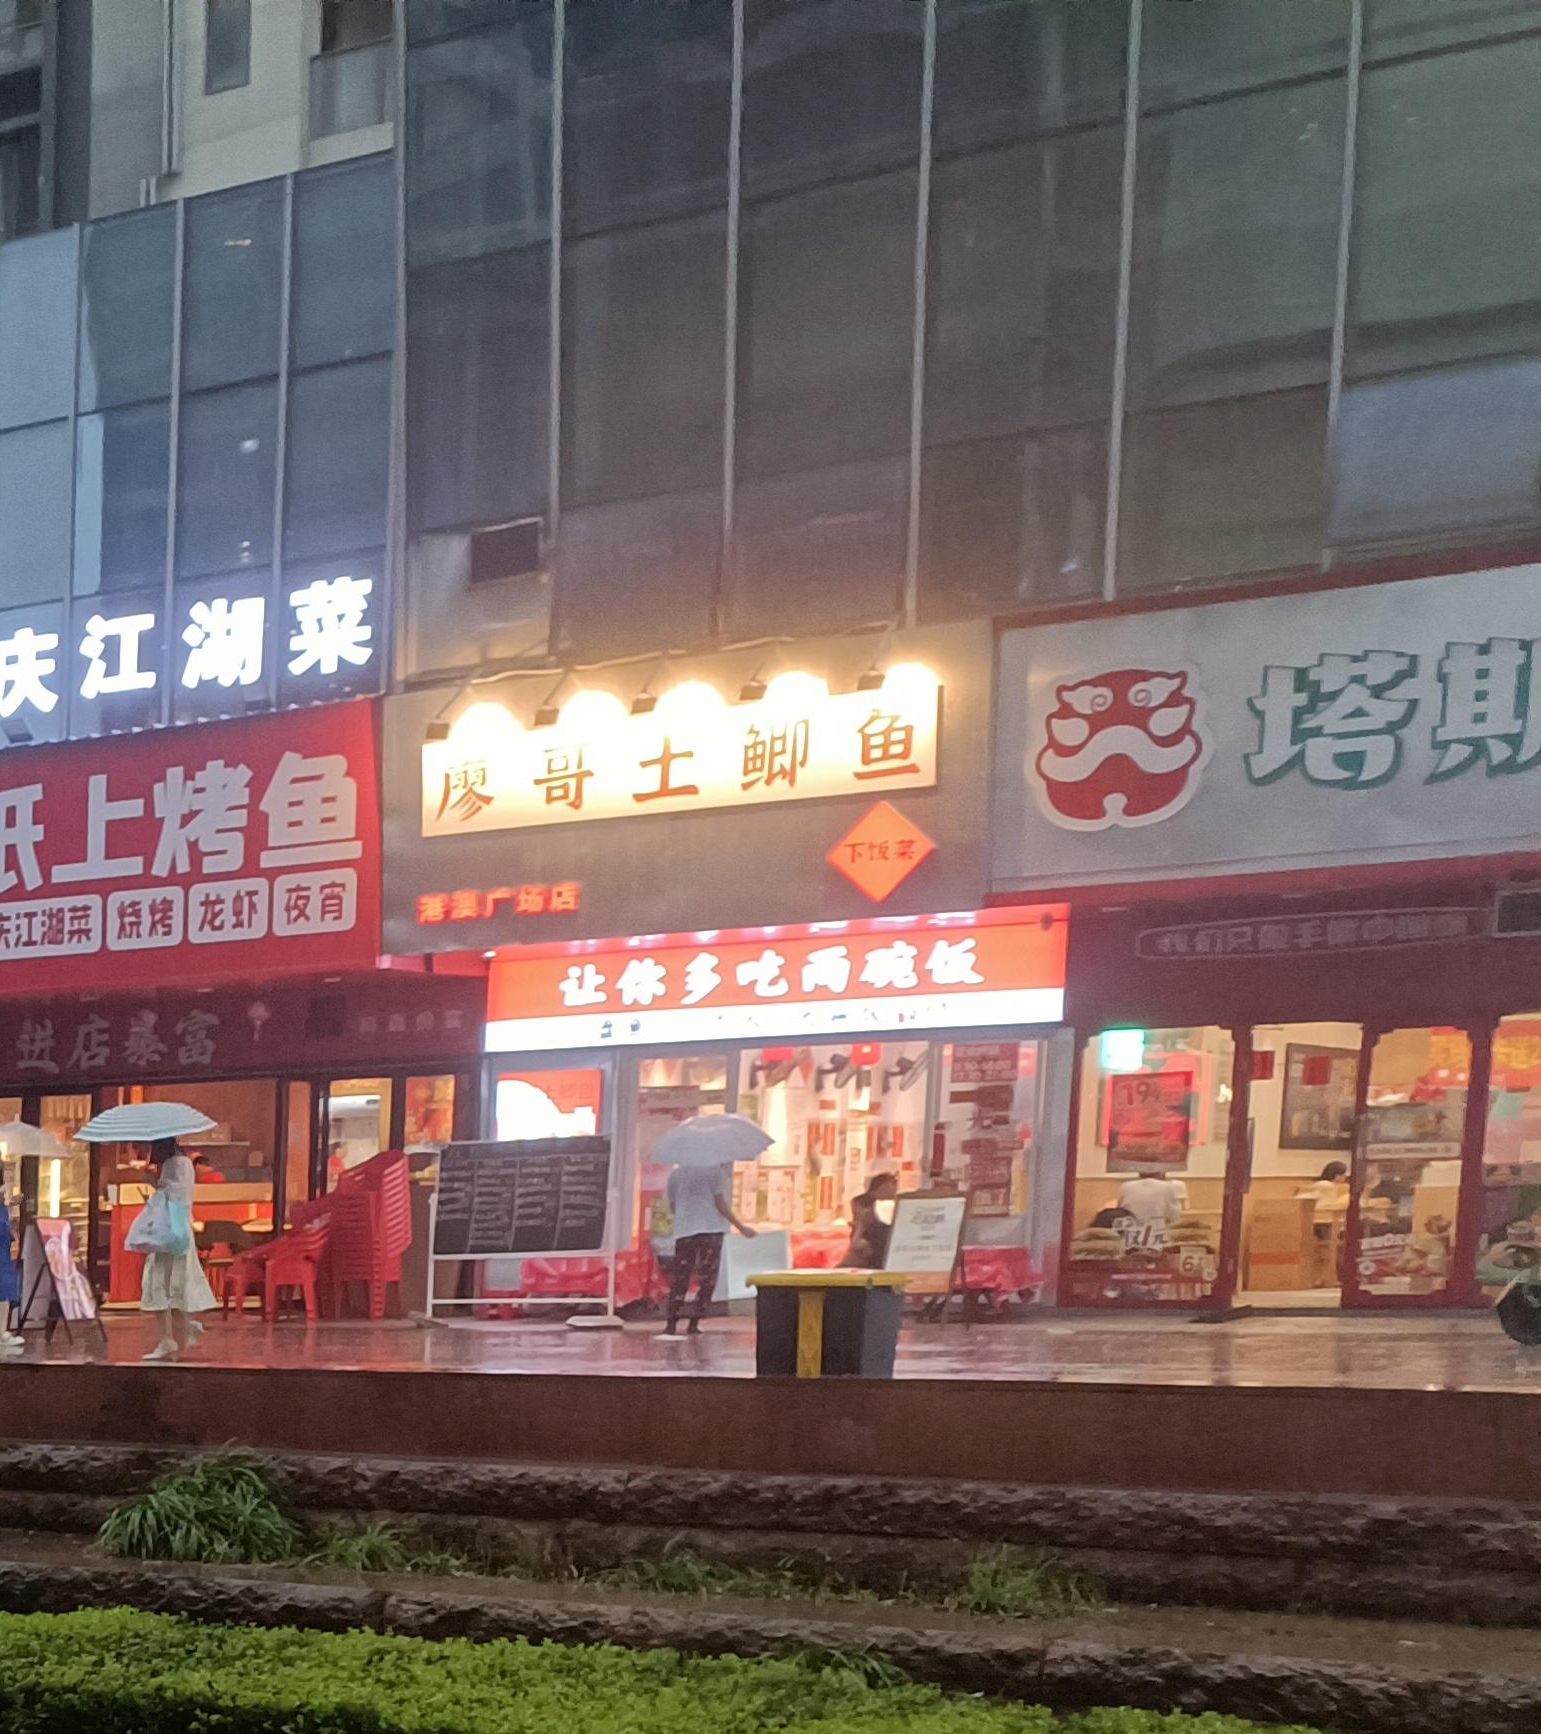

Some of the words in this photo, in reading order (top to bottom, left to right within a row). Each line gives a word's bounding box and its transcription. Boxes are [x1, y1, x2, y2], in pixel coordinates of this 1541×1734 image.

[434, 707, 922, 822] 廖哥土鲫鱼
[844, 839, 918, 862] 下饭菜
[117, 898, 174, 941] 烧烤
[199, 890, 259, 933] 龙虾
[283, 881, 347, 926] 夜宵
[558, 938, 986, 1008] 让你多吃两碗饭
[17, 1008, 221, 1074] 进店暴富
